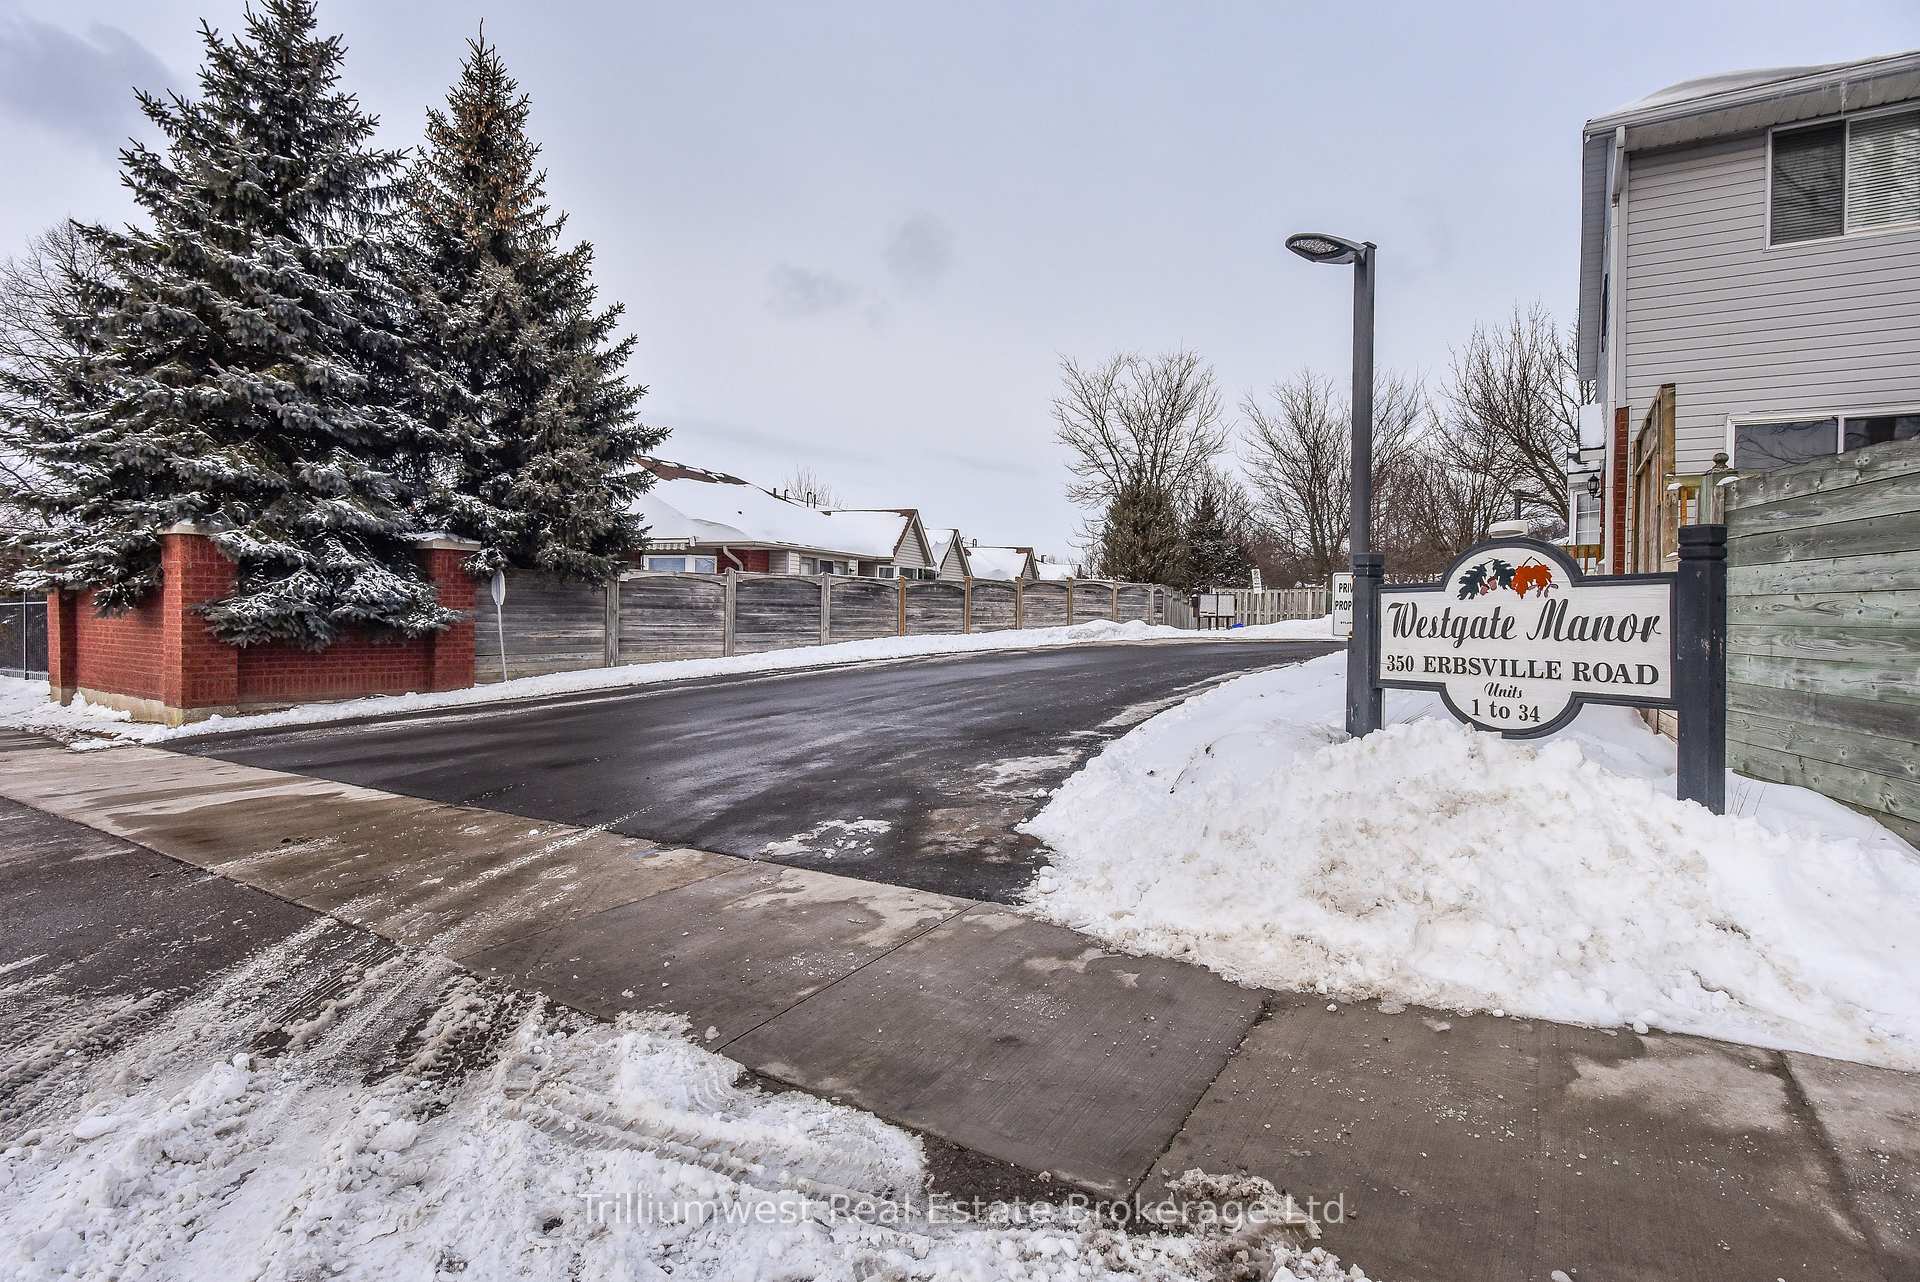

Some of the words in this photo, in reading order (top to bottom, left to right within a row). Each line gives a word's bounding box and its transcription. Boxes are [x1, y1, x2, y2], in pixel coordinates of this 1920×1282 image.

[1386, 601, 1518, 648] Westgate
[1526, 598, 1662, 642] Manor
[1386, 655, 1415, 672] 350
[1423, 655, 1562, 680] ERBSVILLE
[1571, 661, 1659, 685] ROAD
[1483, 681, 1522, 698] Units
[1472, 699, 1480, 716] 1
[1489, 701, 1510, 719] to
[1518, 704, 1540, 722] 34
